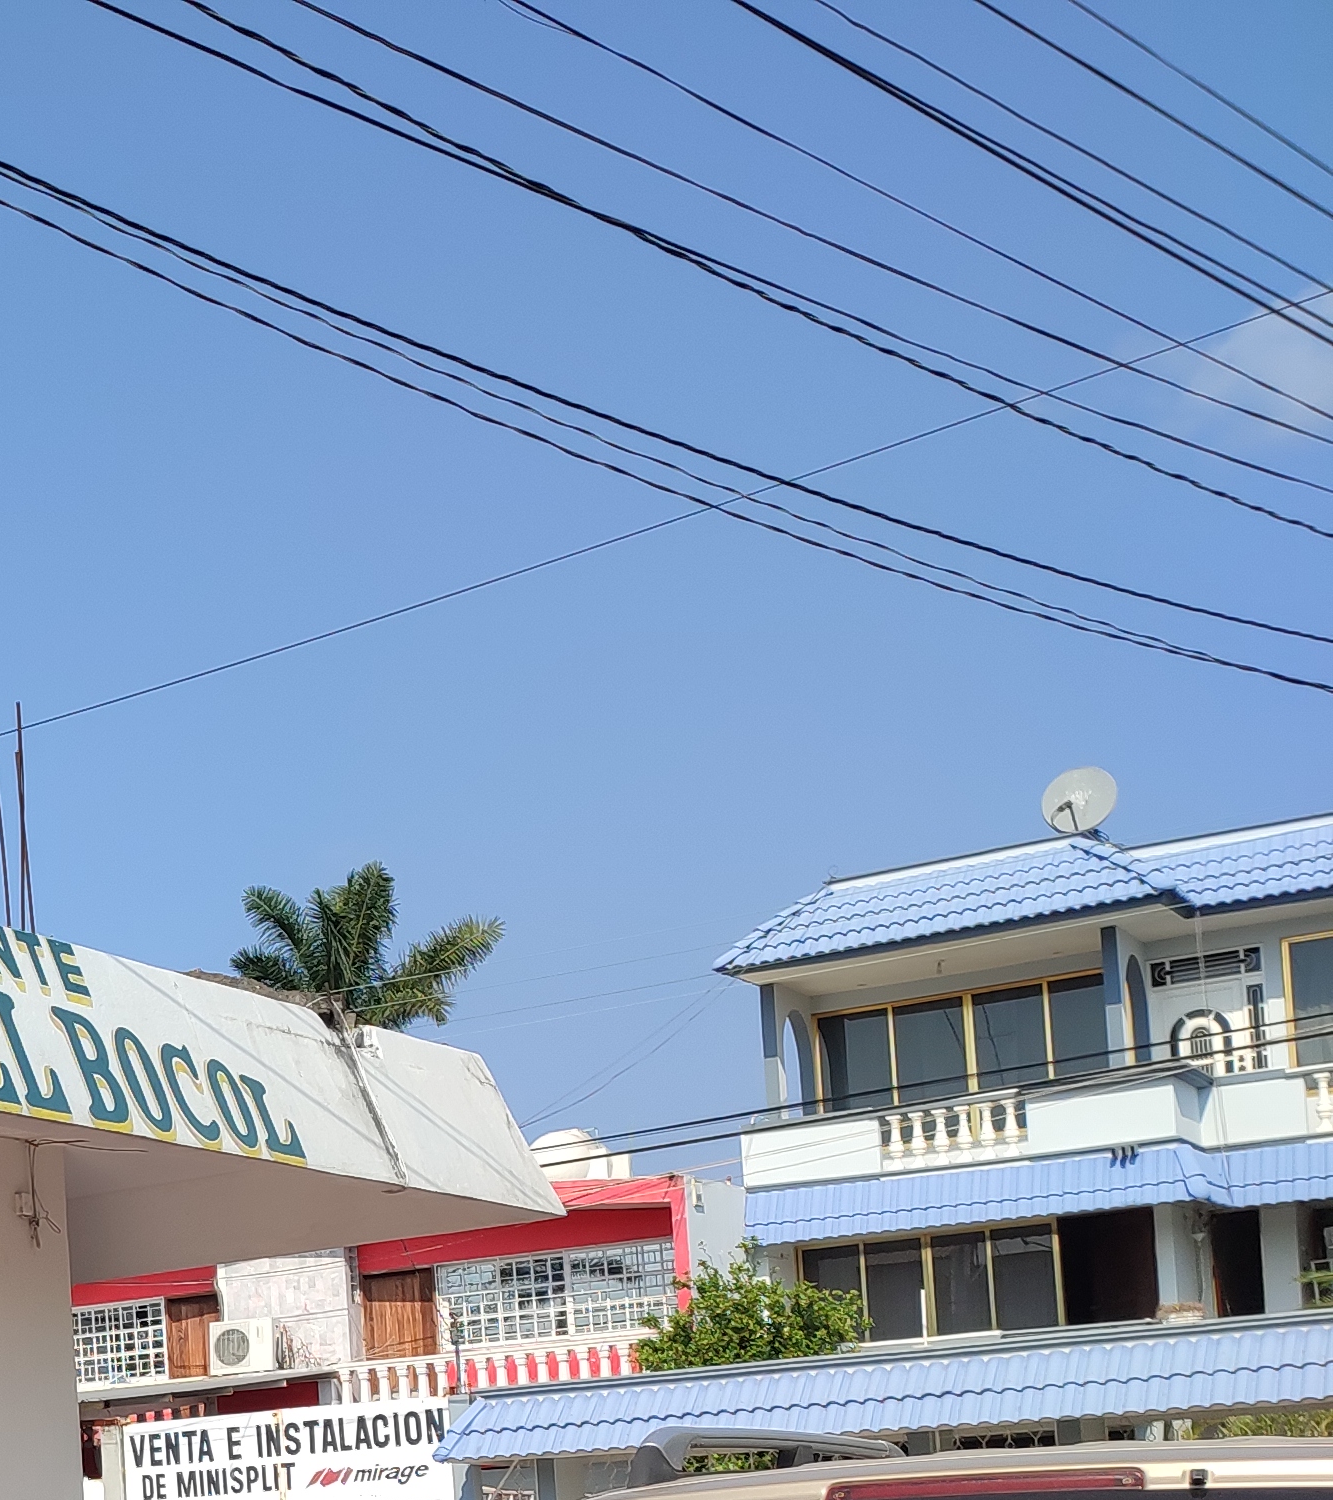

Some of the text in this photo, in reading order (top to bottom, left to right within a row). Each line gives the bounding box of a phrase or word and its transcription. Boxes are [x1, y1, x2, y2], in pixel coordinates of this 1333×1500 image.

[50, 1006, 307, 1166] BOCOL
[129, 1408, 444, 1468] VENTA E INSTALACION
[142, 1463, 295, 1500] DE MINISPLIT
[354, 1464, 429, 1485] mirage
